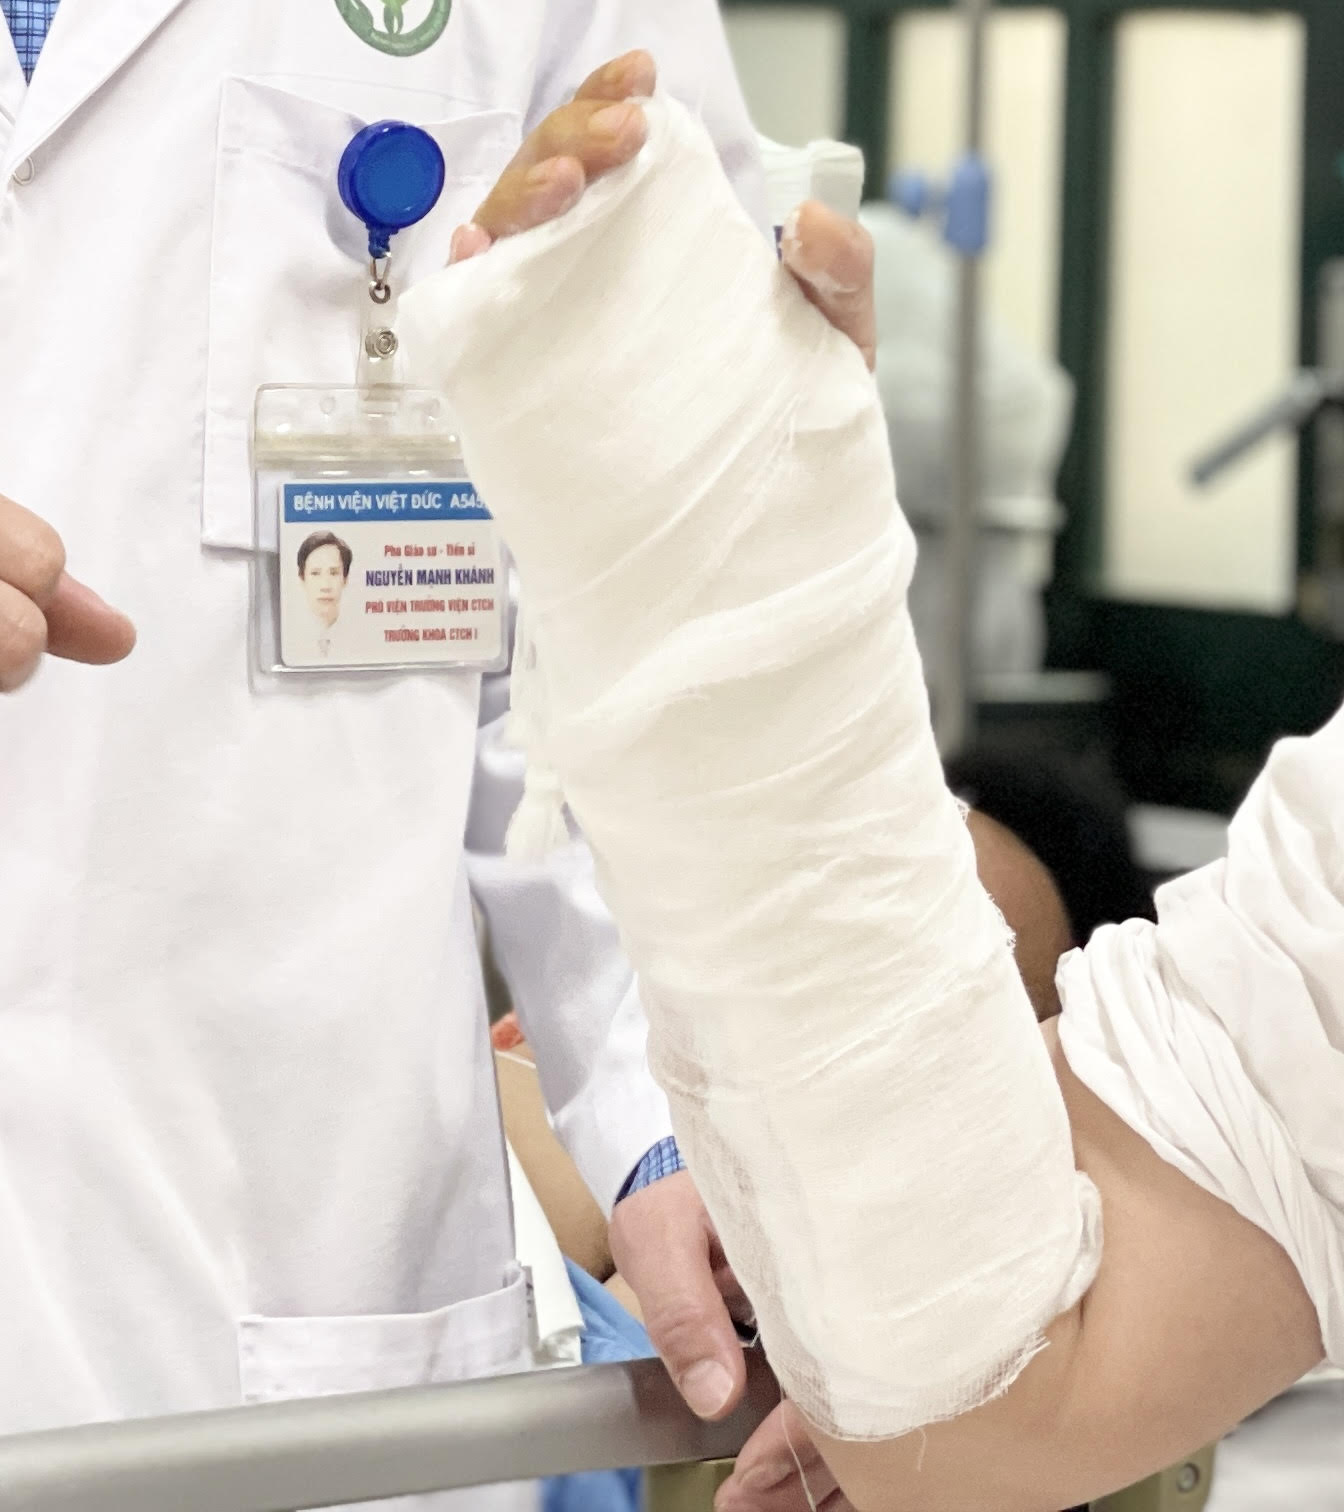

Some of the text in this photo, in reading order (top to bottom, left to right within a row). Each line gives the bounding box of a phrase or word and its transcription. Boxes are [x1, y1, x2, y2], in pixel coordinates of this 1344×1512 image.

[293, 490, 335, 515] BỆNH
[338, 489, 372, 515] VIỆN
[375, 489, 408, 514] VIỆT
[411, 489, 443, 511] ĐỨC
[365, 563, 495, 588] NGUYỄN MẠNH KHÁNH
[422, 627, 447, 641] KHOA
